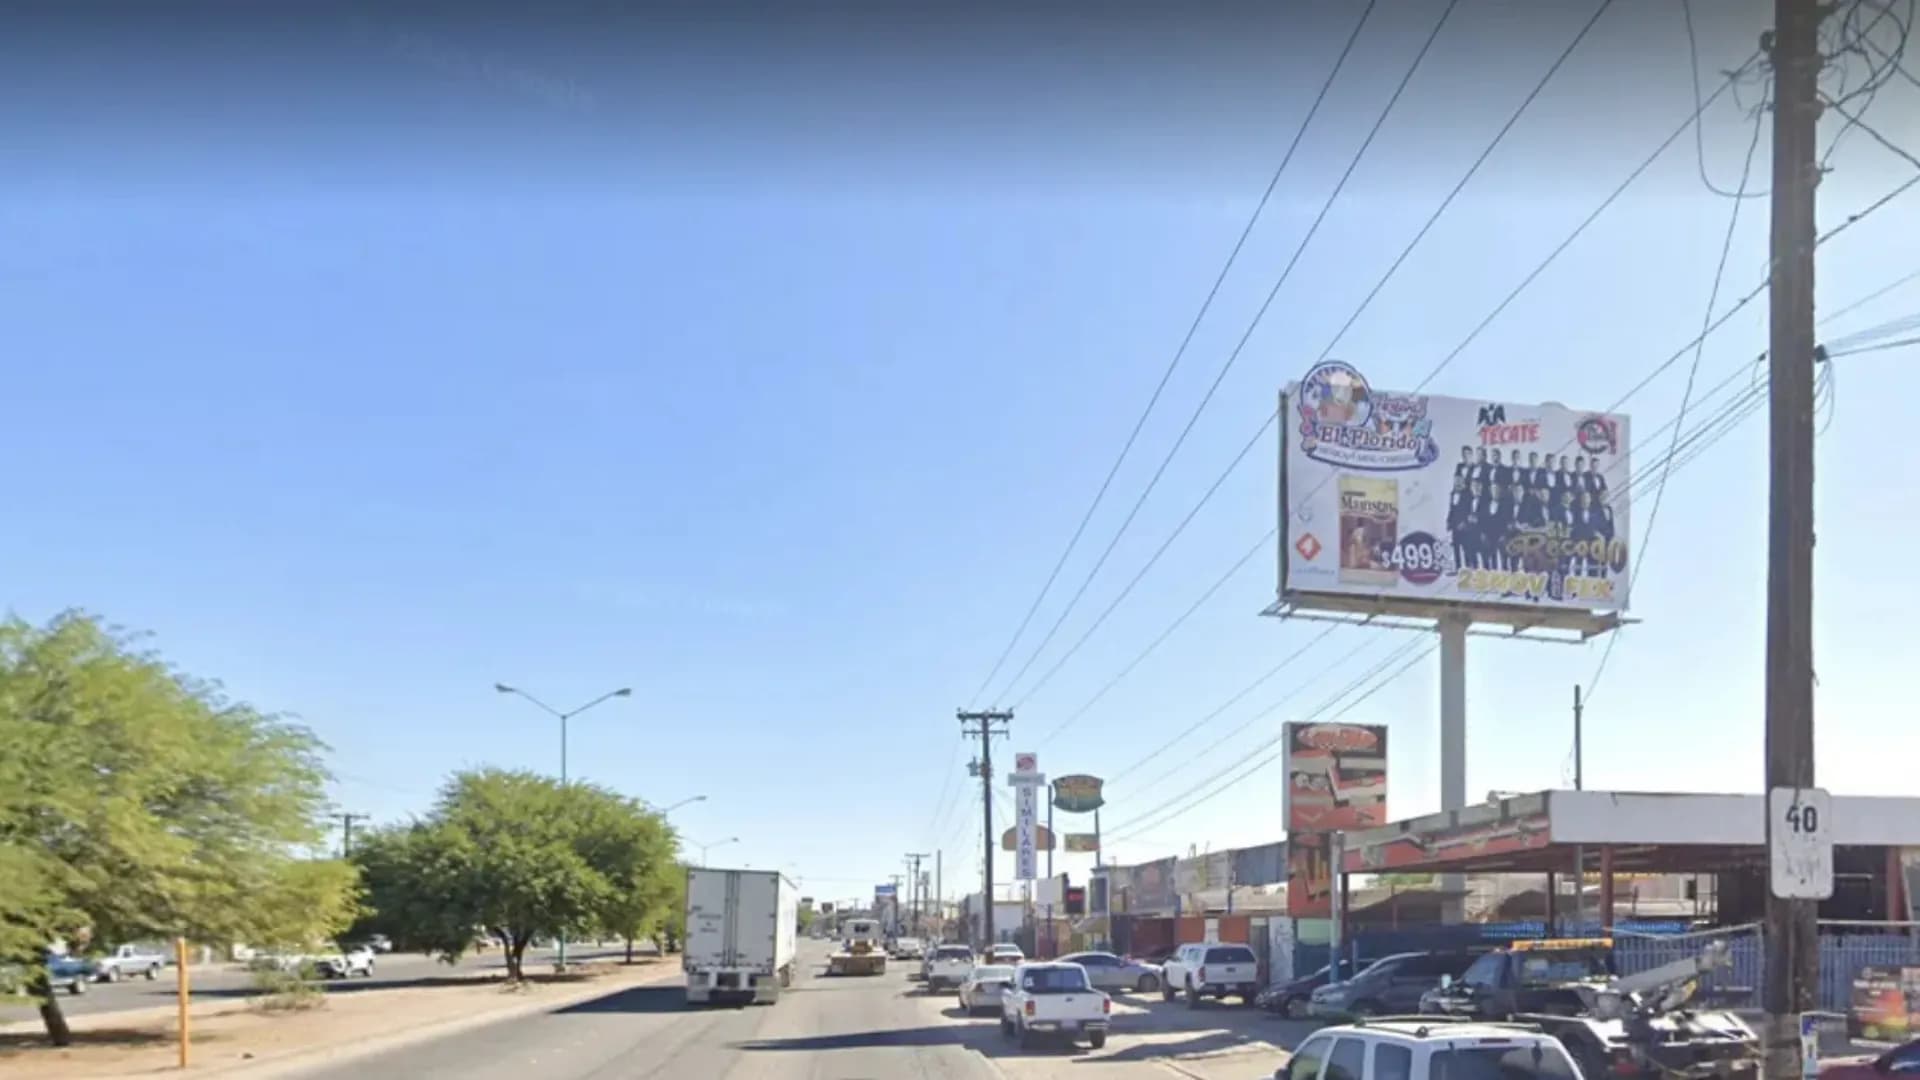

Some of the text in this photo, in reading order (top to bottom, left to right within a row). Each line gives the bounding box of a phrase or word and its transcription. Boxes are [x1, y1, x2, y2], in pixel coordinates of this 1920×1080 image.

[1321, 426, 1418, 449] El Florido
[1480, 424, 1541, 446] TECATE
[1786, 806, 1817, 833] 40
